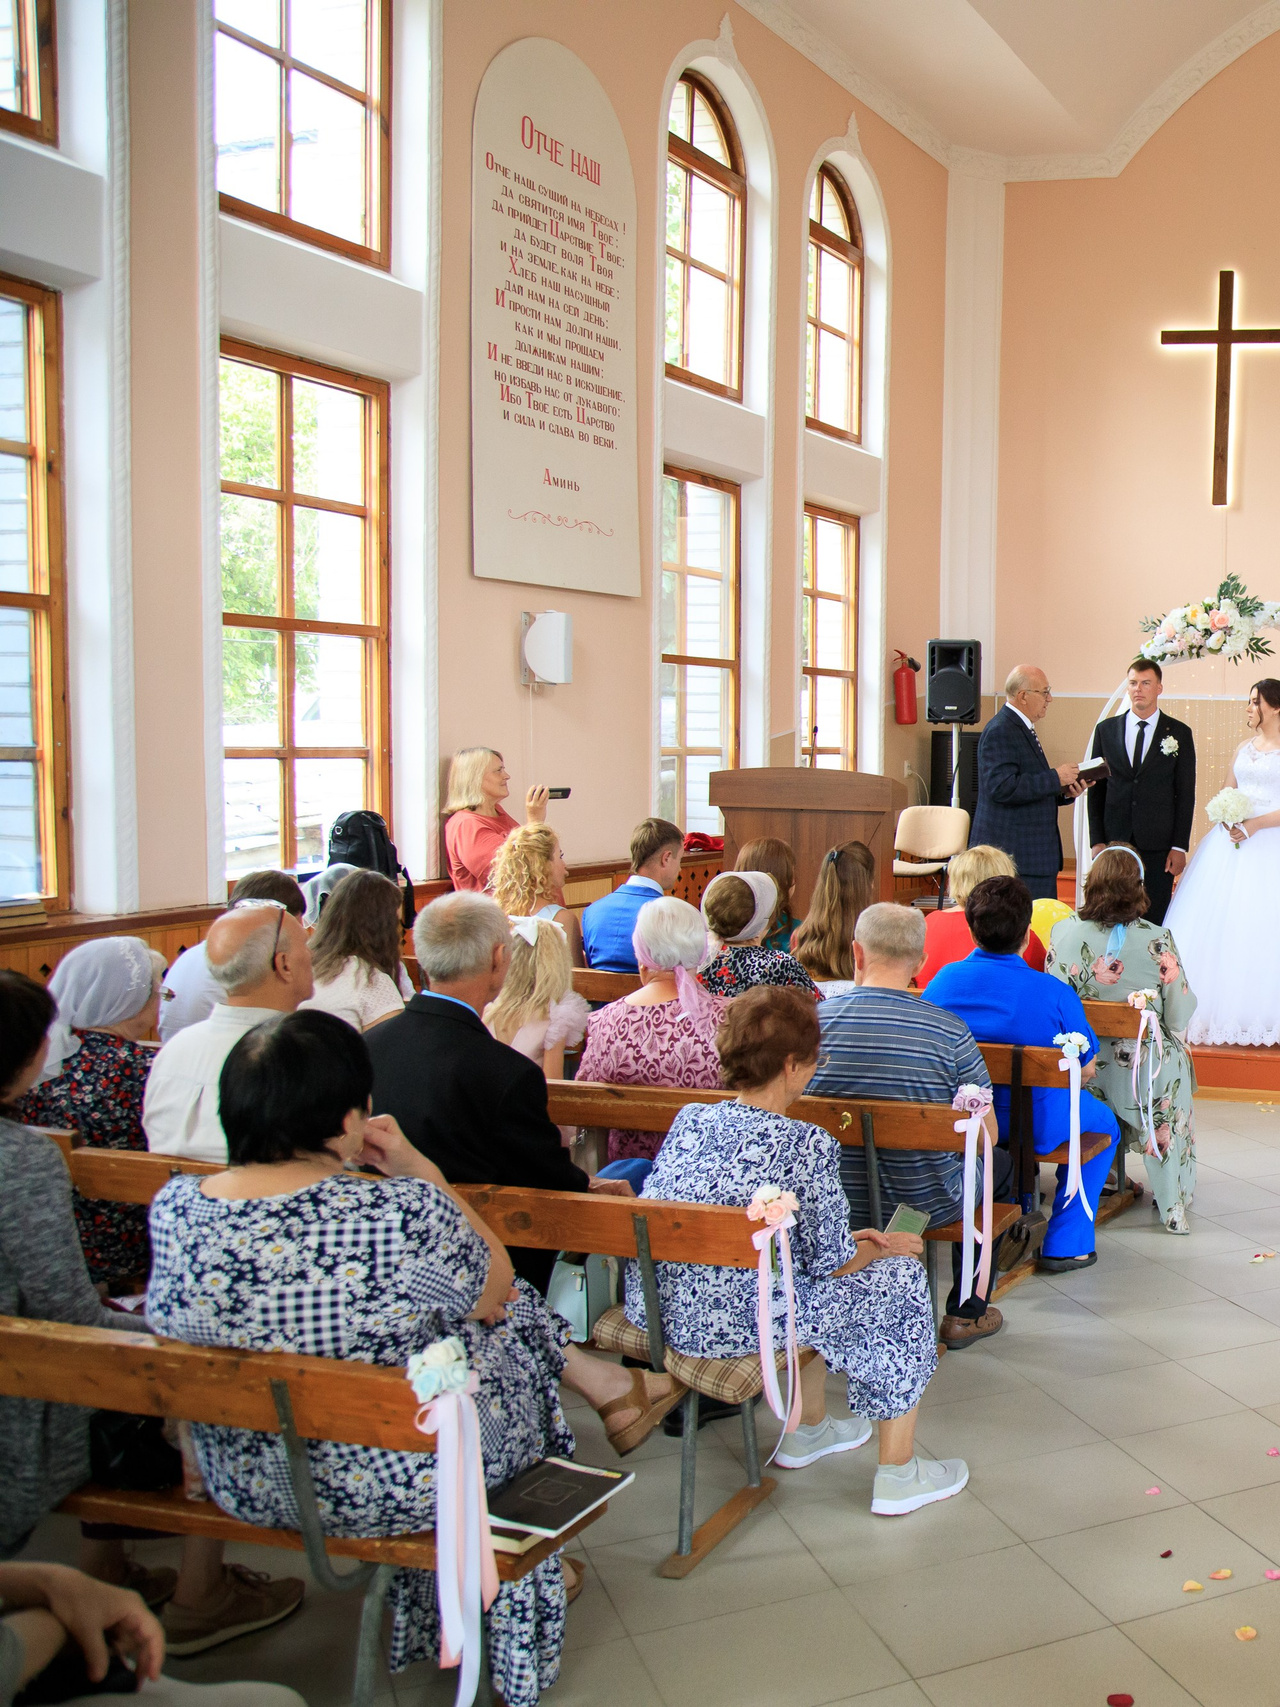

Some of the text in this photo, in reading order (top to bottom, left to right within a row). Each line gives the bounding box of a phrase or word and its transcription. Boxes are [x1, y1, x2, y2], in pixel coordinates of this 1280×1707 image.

[521, 115, 601, 186] ОТЧЕ НАШ
[486, 152, 511, 179] ОТЧЕ
[571, 200, 582, 214] НА
[492, 199, 504, 214] ДА
[550, 218, 594, 254] ЦАРСТВИЕ
[501, 185, 514, 200] ДА
[519, 193, 565, 223] СВЯТИТСЯ
[568, 215, 585, 232] ИМЯ
[501, 240, 507, 252] И
[512, 245, 524, 259] НА
[561, 266, 577, 282] КАК
[581, 274, 592, 288] НА
[514, 228, 614, 279] ДА БУДЕТ ВОЛЯ ТВОЯ
[504, 280, 524, 296] ДАЙ
[528, 289, 545, 305] НАМ
[548, 297, 560, 311] НА
[563, 303, 580, 318] СЕЙ
[509, 255, 610, 313] ХЛЕБ НАШ НАСУЩНЫЙ
[495, 287, 505, 308] И
[509, 300, 541, 321] ПРОСТИ
[544, 313, 562, 329] НАМ
[565, 321, 593, 341] ДОЛГИ
[488, 341, 498, 362] И
[501, 353, 513, 367] НЕ
[516, 358, 544, 376] ВВЕДИ
[547, 369, 563, 383] НАС
[566, 375, 572, 386] В
[515, 321, 605, 362] КАК И МЫ ПРОЩАЕМ
[515, 339, 567, 366] ДОЛЖНИКАМ
[494, 370, 507, 383] НО
[509, 374, 542, 394] ИЗБАВЬ
[544, 385, 560, 399] НАС
[563, 392, 573, 404] ОТ
[500, 383, 615, 433] ИБО ТВОЕ ЕСТЬ ЦАРСТВО
[503, 409, 510, 421] И
[514, 412, 536, 428] СИЛА
[539, 419, 546, 431] И
[549, 422, 575, 439] СЛАВА
[579, 430, 590, 443] ВО
[543, 468, 580, 492] АМИНЬ
